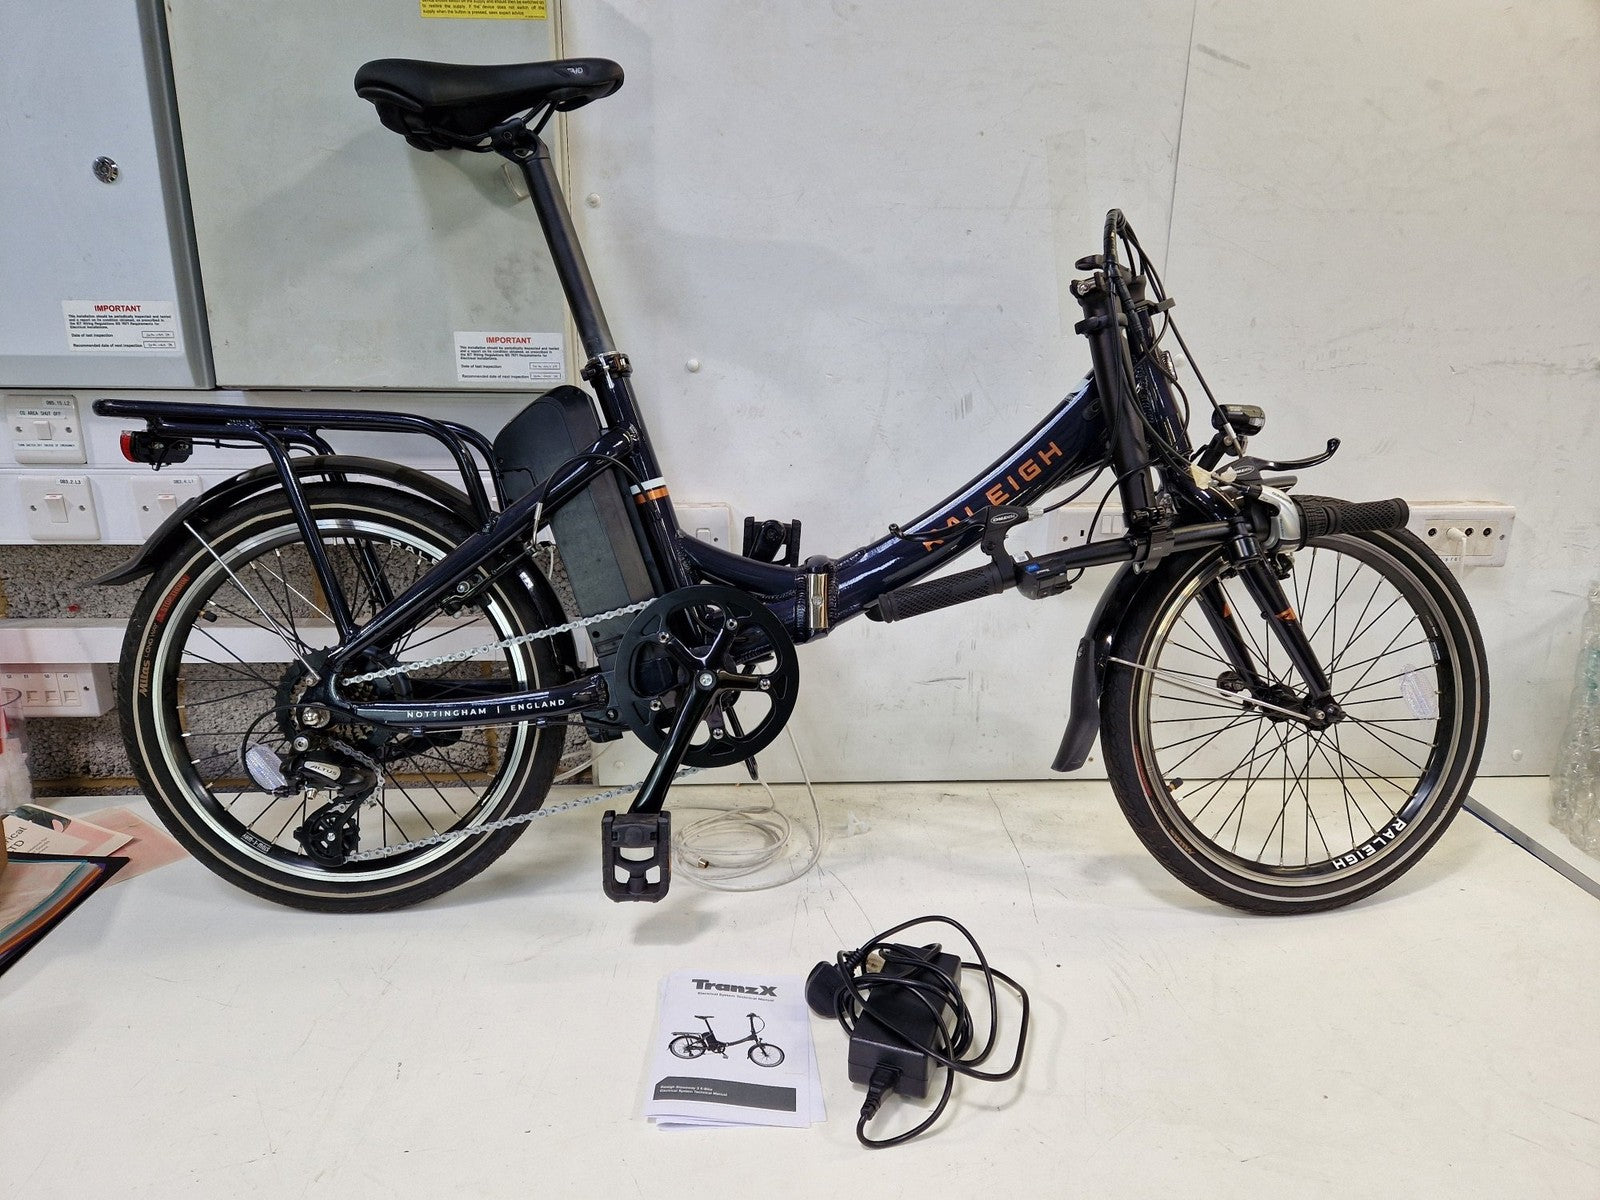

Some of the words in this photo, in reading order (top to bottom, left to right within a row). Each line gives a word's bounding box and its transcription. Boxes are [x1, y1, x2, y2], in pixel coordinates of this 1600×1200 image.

[390, 540, 440, 566] RALE
[139, 659, 151, 697] Mitas
[145, 637, 154, 658] LONG
[407, 708, 487, 718] NOTTINGHAM
[510, 699, 565, 711] ENGLAND
[310, 765, 337, 776] ALTUS
[1332, 818, 1407, 870] RALEIGH
[692, 978, 777, 997] TranzX
